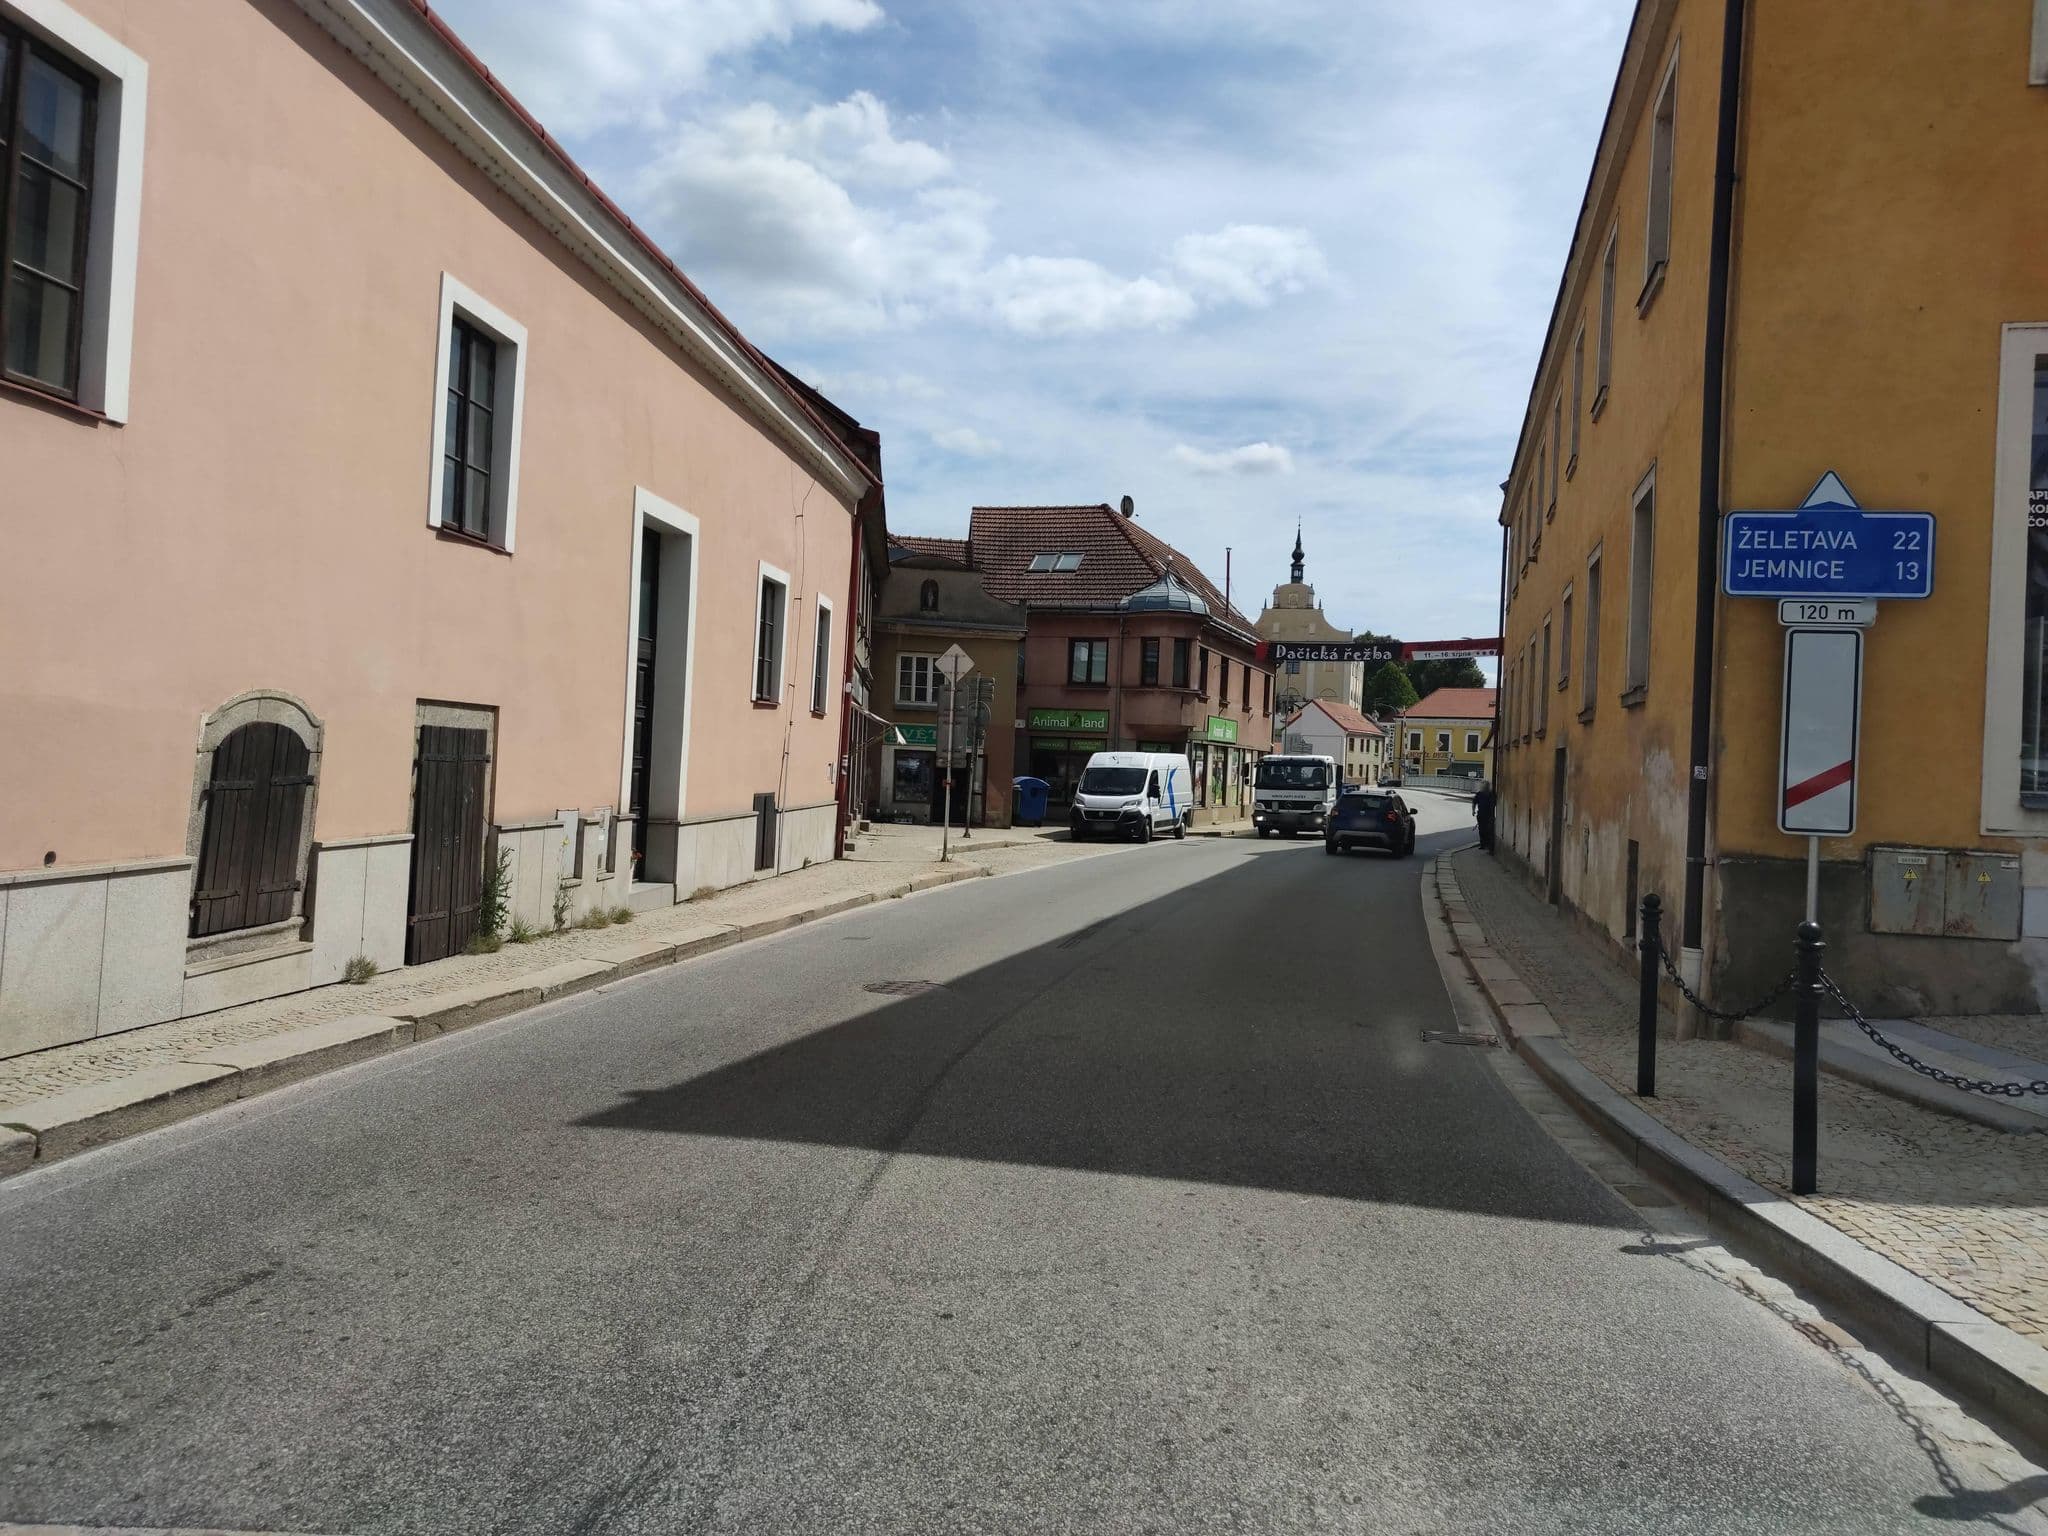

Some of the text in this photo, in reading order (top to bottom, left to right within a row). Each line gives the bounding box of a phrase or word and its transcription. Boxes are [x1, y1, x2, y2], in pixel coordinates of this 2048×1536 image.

[1737, 526, 1921, 551] ŽELETAVA 22
[1738, 559, 1919, 581] JEMNICE 13
[1799, 605, 1855, 620] 120 m
[1275, 644, 1393, 661] Dačická řežba
[1032, 715, 1069, 728] Animal
[1081, 716, 1105, 729] land
